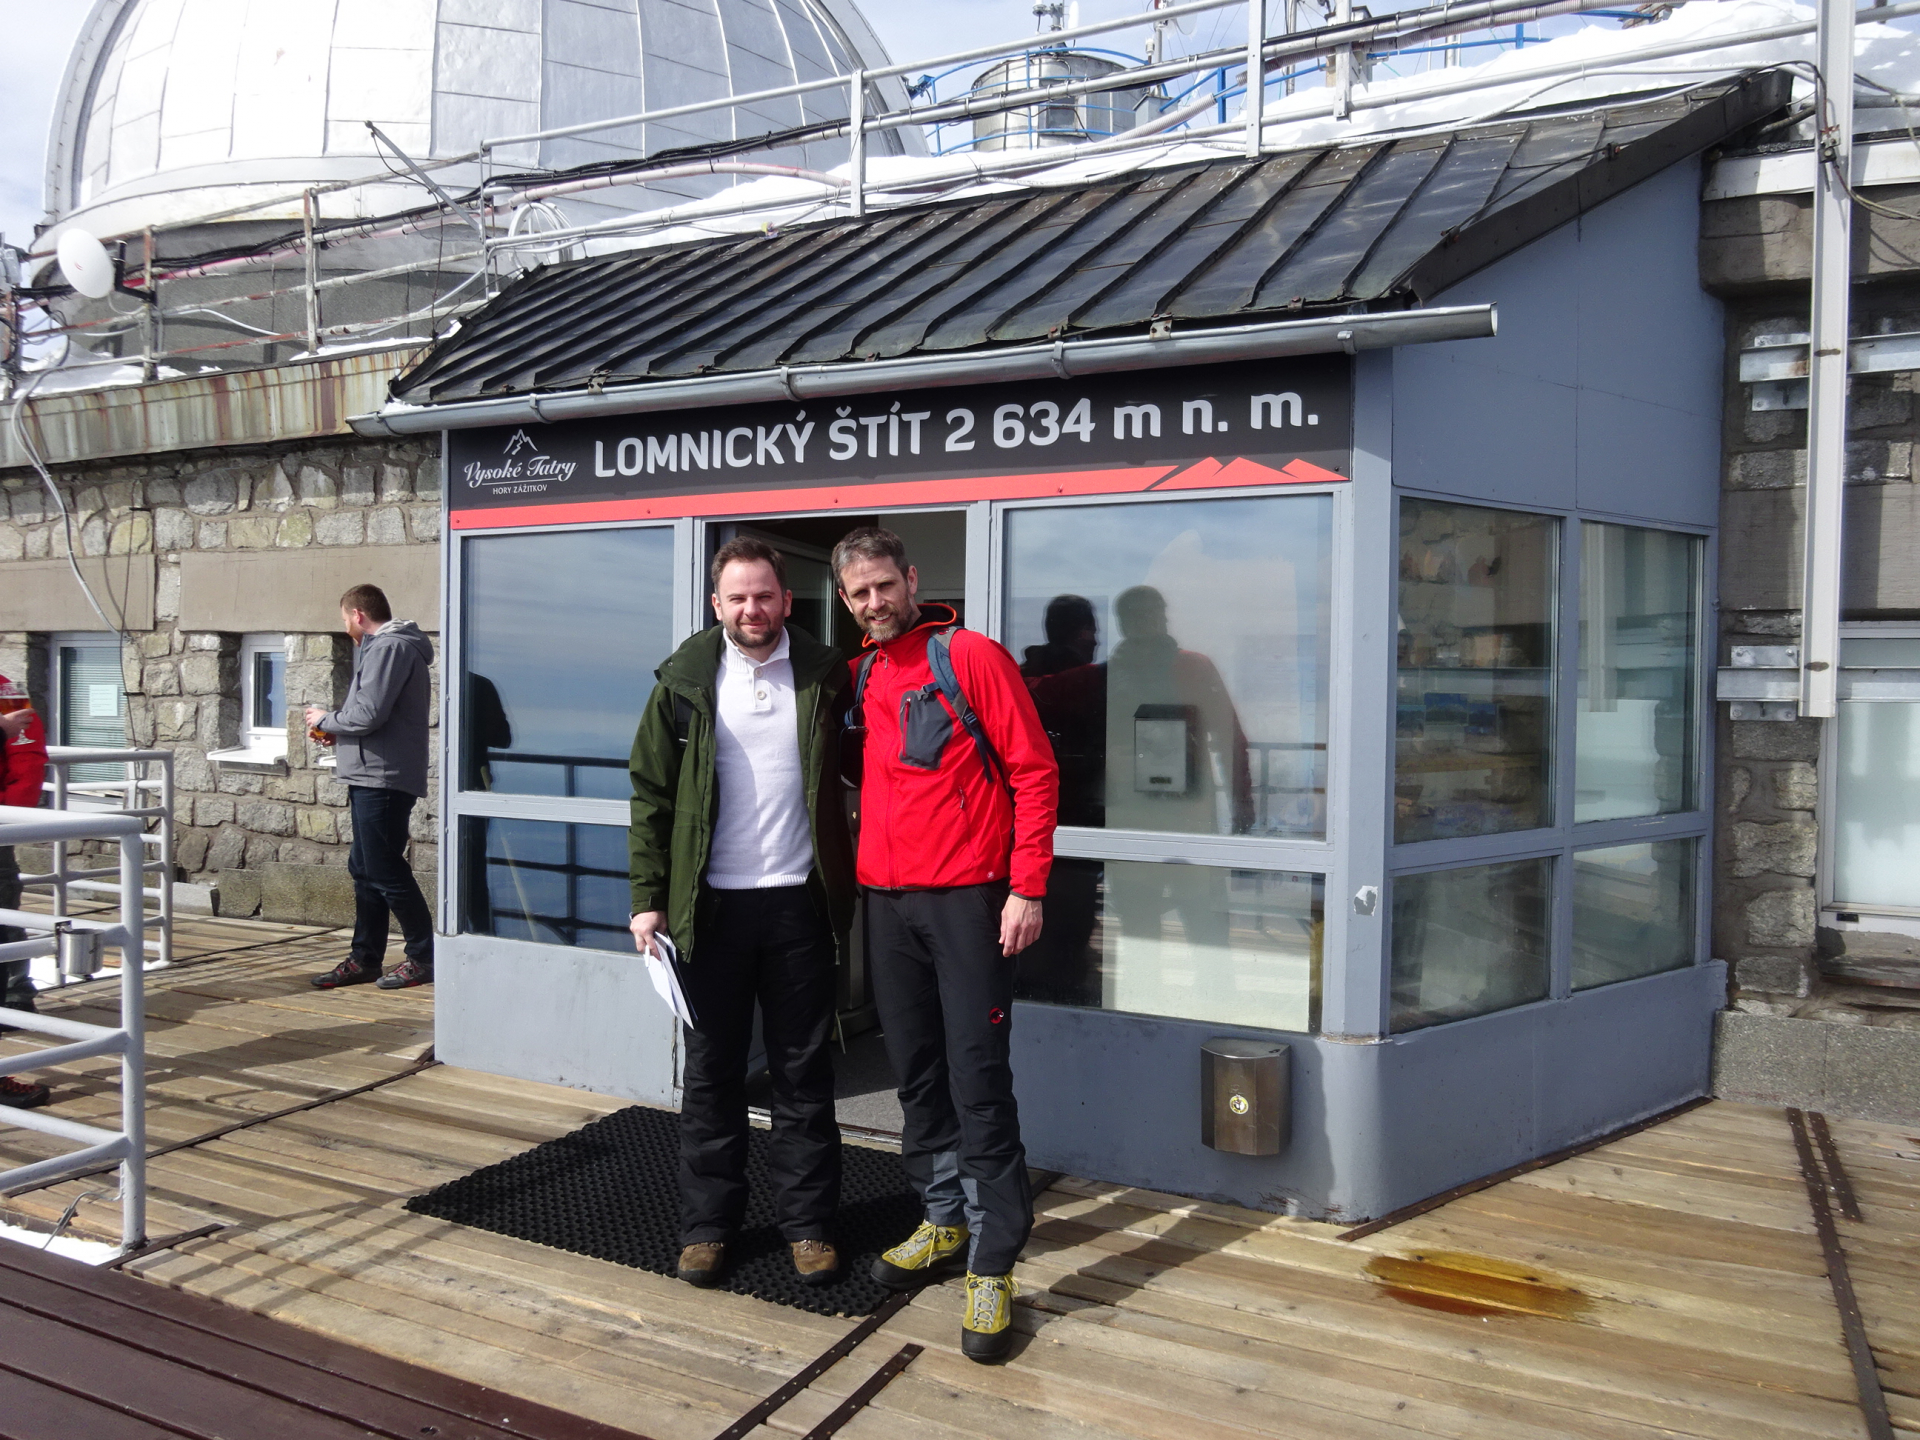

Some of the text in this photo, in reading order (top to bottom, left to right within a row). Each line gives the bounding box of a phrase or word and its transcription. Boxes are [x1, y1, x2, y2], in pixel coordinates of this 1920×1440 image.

[595, 391, 1319, 478] LOMNICKÝ ŠTÍT 2 634 m n. m.
[464, 455, 578, 488] Vysoké Tatry
[492, 484, 548, 495] HORY ZÁŽITKOV
